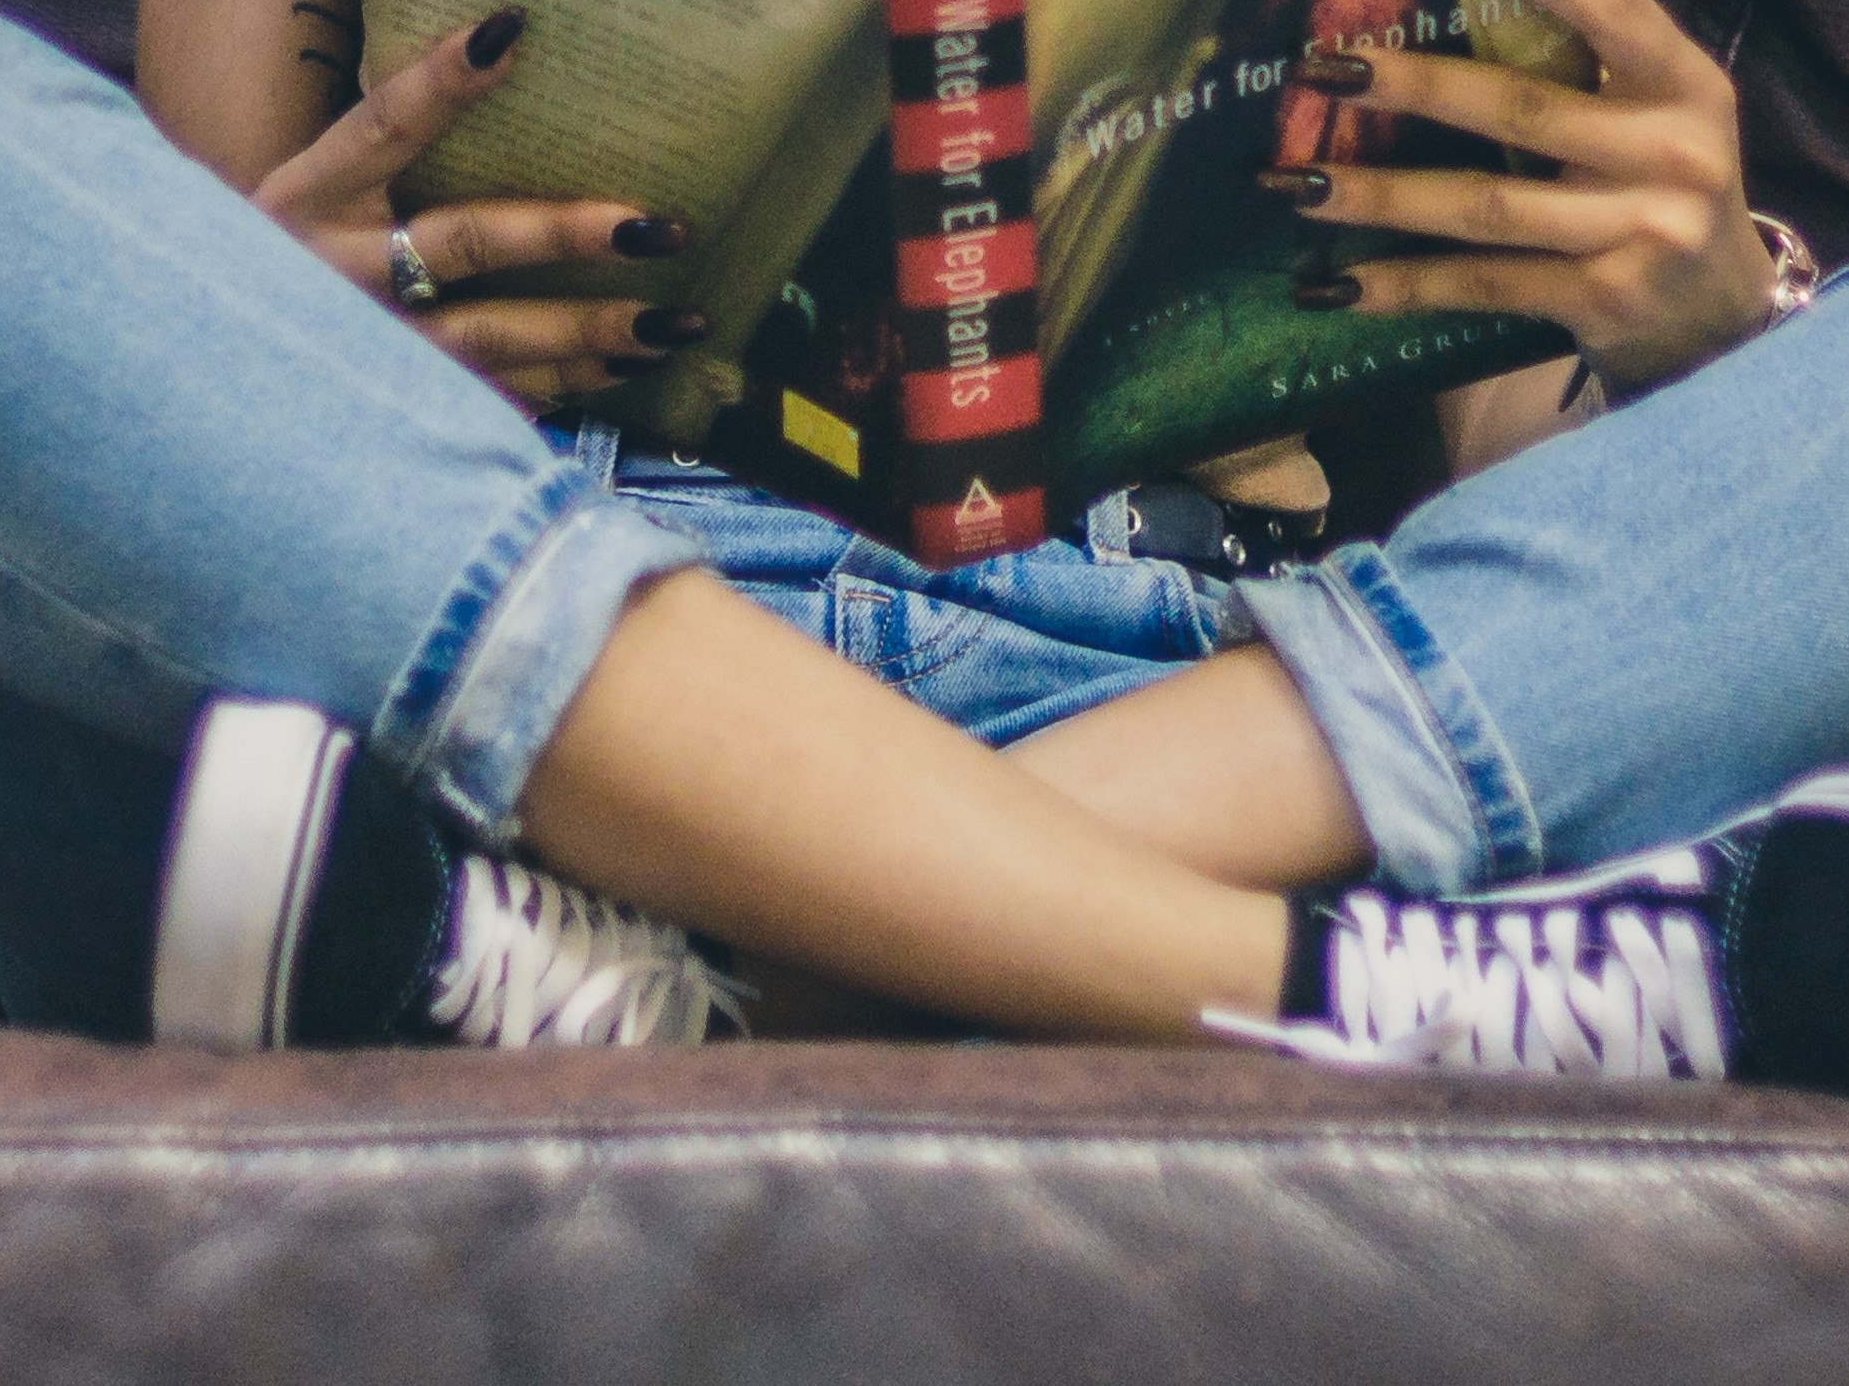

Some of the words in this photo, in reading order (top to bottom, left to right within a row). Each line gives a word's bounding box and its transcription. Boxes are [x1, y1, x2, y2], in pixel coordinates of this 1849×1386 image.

[1084, 78, 1219, 159] Water
[1235, 54, 1288, 99] for
[938, 128, 996, 188] for
[934, 200, 1000, 409] Elephants
[1270, 354, 1378, 400] SARA
